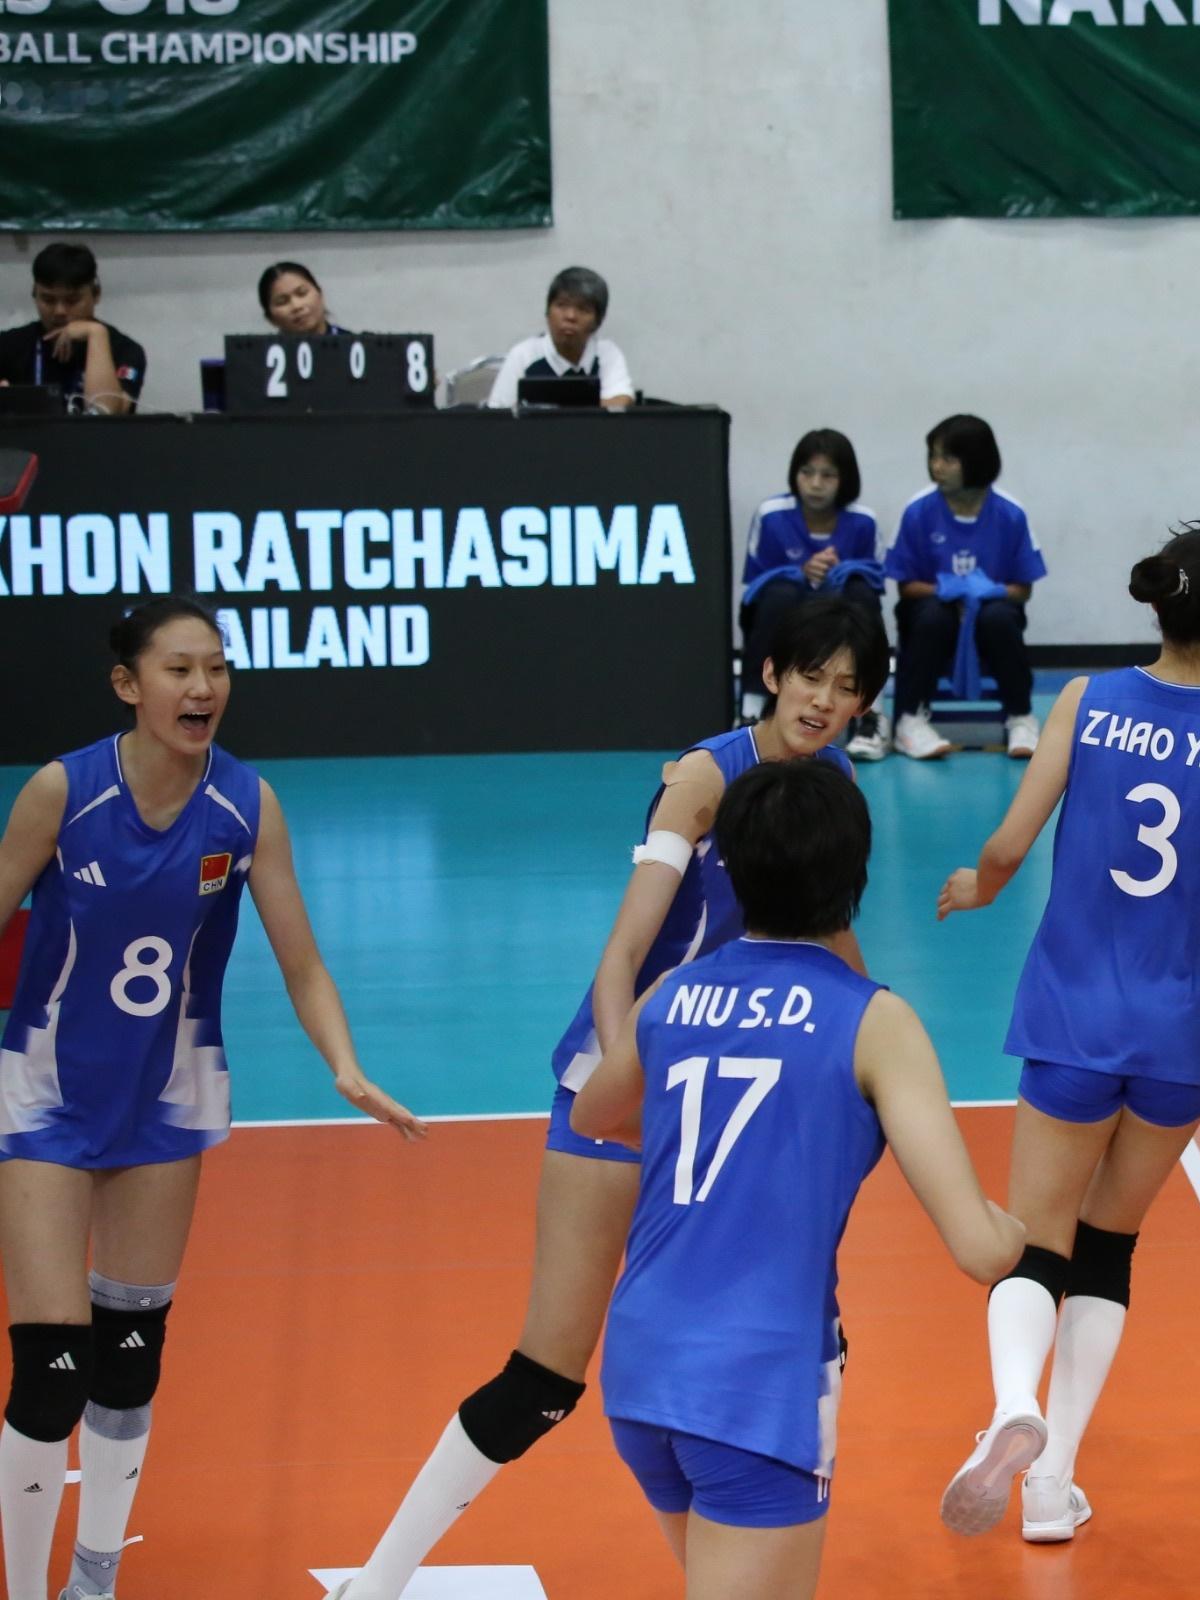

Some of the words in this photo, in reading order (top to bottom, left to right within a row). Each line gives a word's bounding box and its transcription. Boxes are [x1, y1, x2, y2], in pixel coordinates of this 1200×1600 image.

[101, 32, 417, 64] CHAMPIONSHIP
[266, 344, 287, 397] 2
[297, 341, 312, 379] 0
[350, 341, 365, 379] 0
[406, 341, 428, 392] 8
[0, 513, 171, 596] HON
[192, 504, 696, 592] RATCHASIMA
[214, 604, 430, 669] AILAND
[1080, 709, 1175, 761] ZHAO
[1109, 782, 1181, 897] 3
[203, 879, 224, 892] CHN
[110, 935, 173, 1017] 8
[666, 984, 739, 1027] NIU
[738, 985, 816, 1034] S.D.
[666, 1056, 782, 1205] 17
